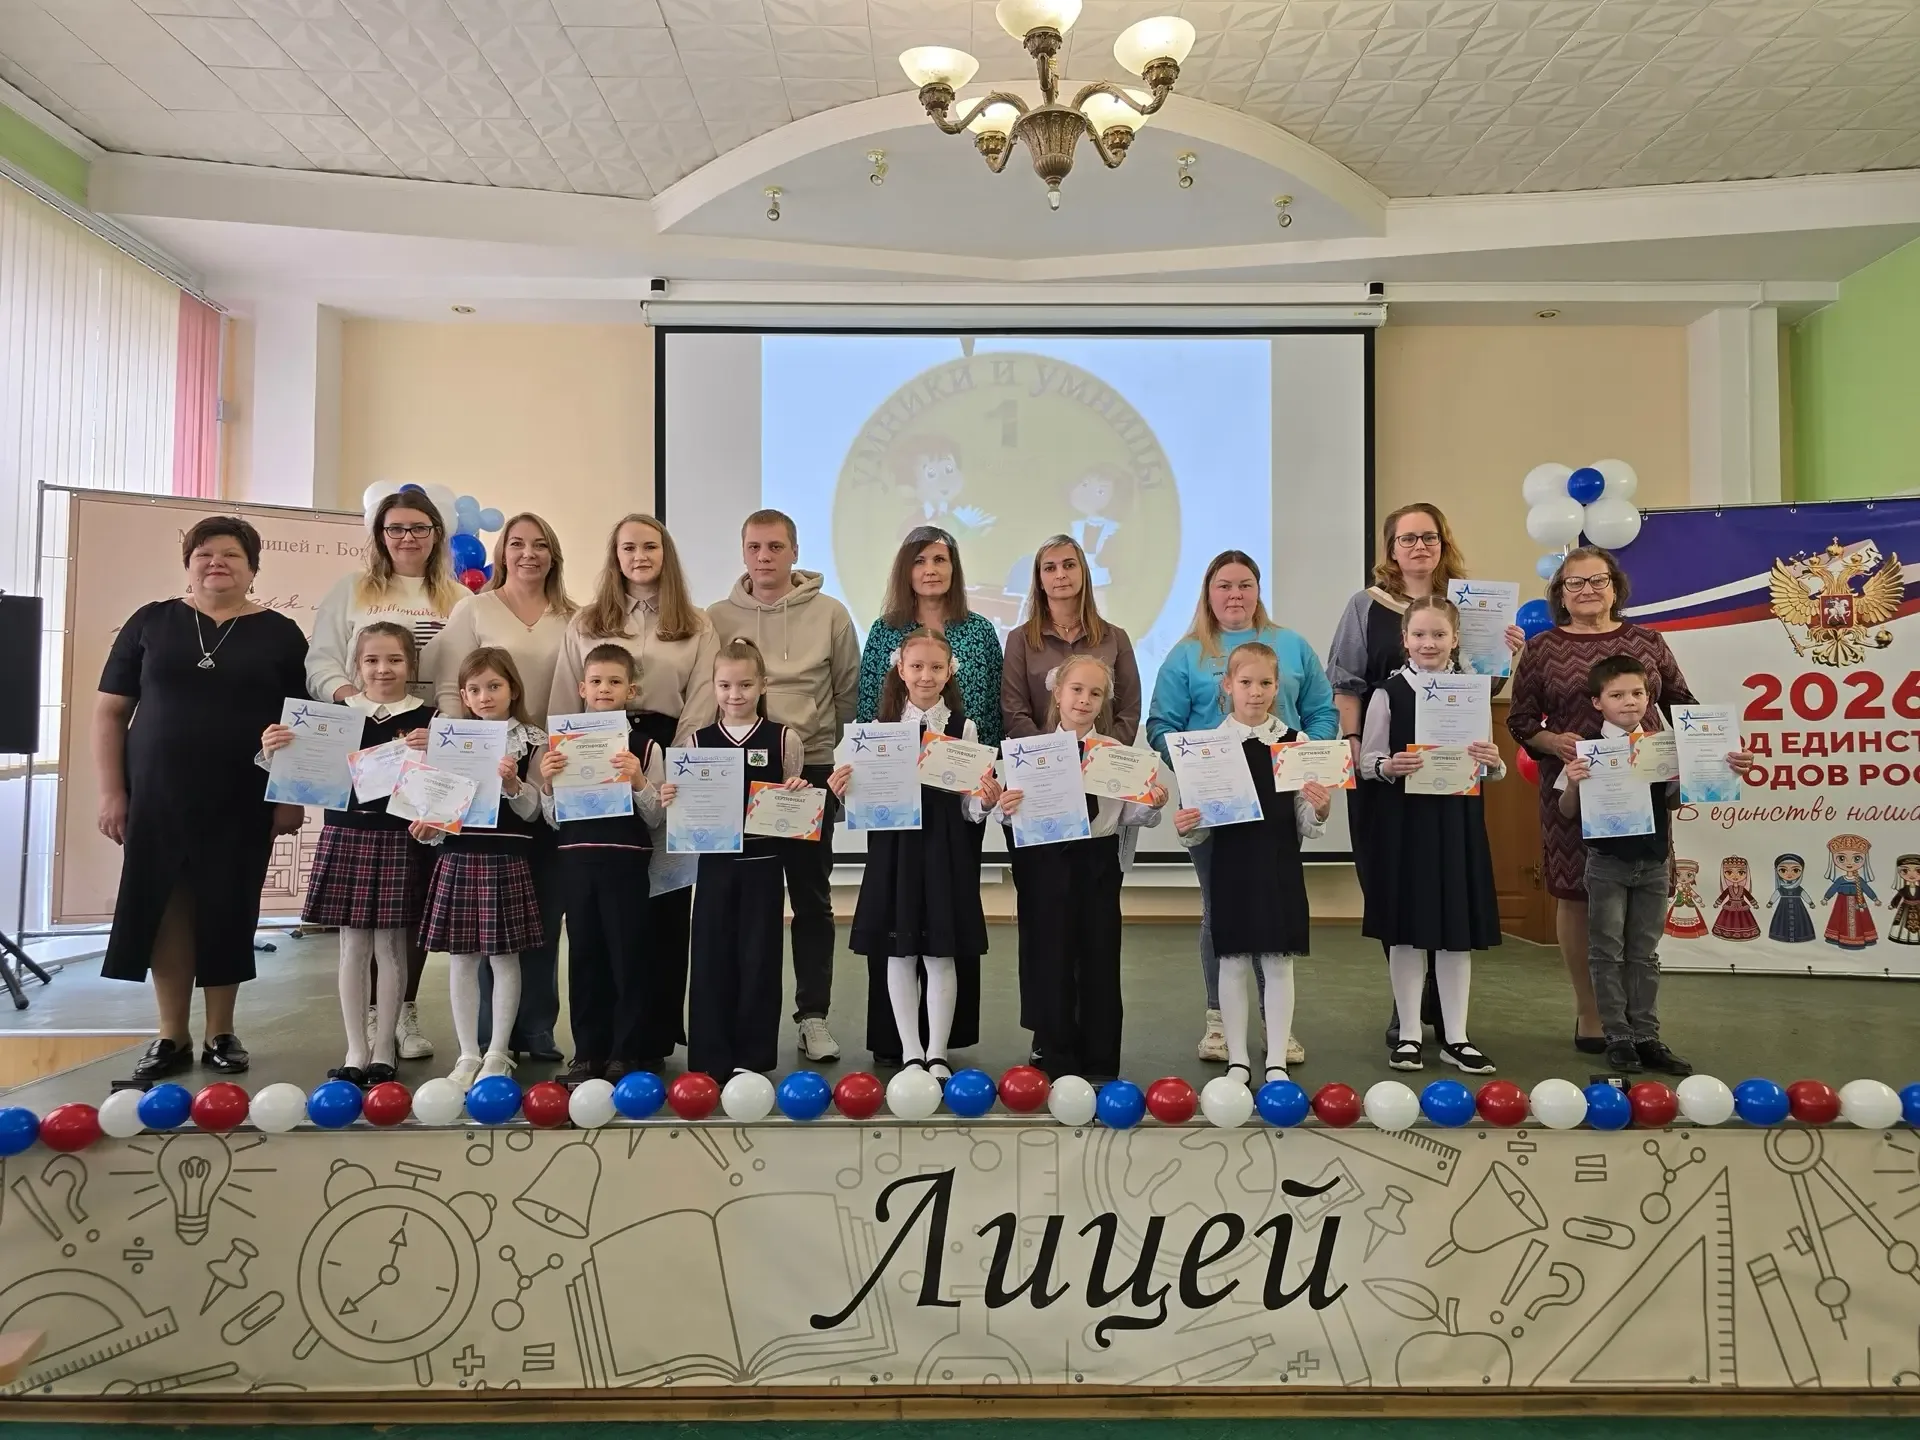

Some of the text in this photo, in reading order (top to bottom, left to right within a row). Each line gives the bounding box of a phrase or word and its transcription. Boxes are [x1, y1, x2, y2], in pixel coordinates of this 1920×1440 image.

[985, 400, 1019, 448] 1
[316, 543, 329, 555] г.
[1742, 670, 1920, 722] 2026
[1859, 763, 1920, 786] РО
[1710, 796, 1837, 829] единстве
[809, 1166, 1349, 1348] Лицей
